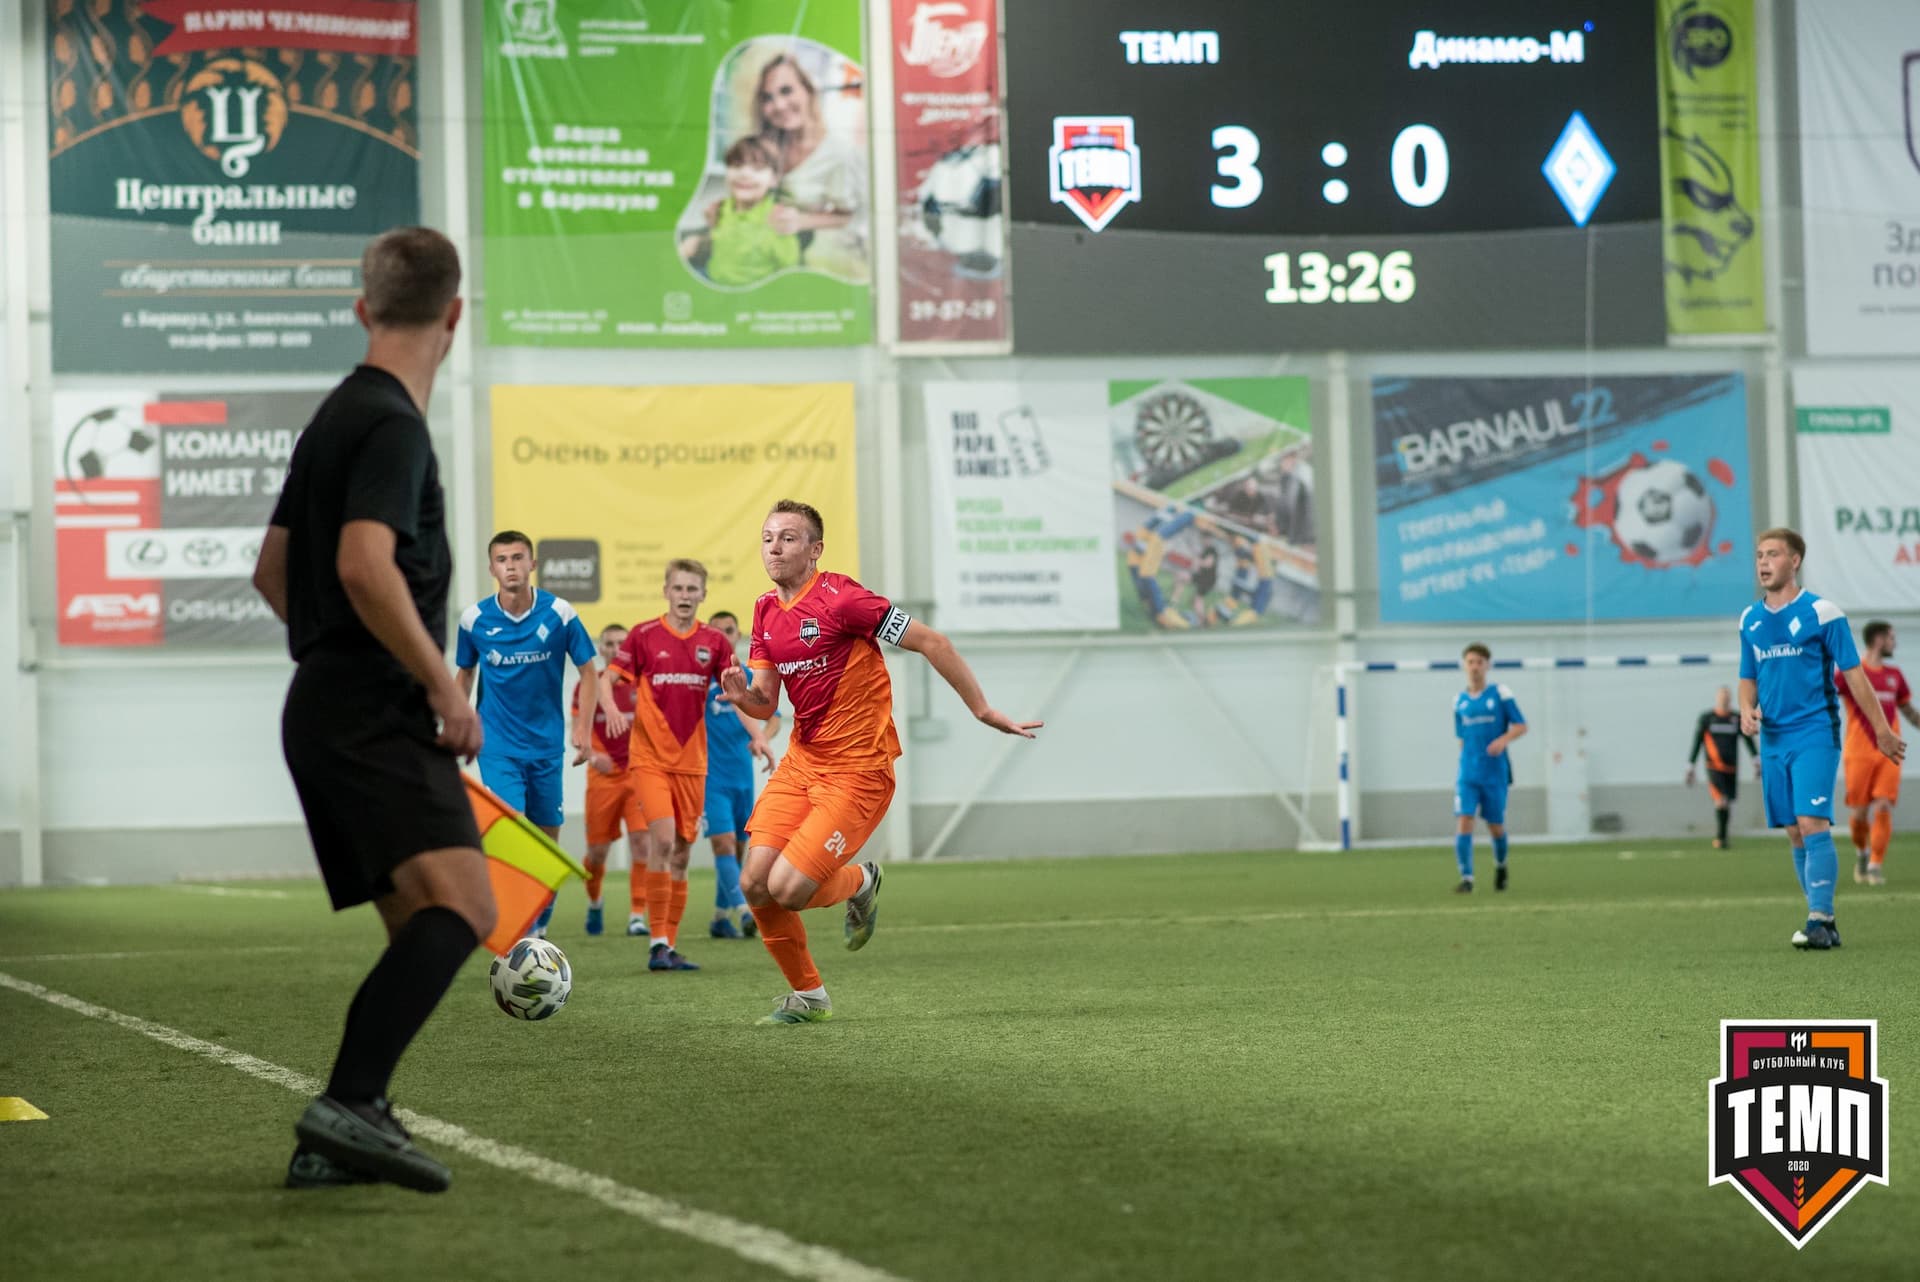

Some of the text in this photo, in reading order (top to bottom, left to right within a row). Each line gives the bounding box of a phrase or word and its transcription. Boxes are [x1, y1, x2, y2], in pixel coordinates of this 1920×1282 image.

[1119, 31, 1219, 64] ТЕМП
[1408, 30, 1584, 68] Динамо-М
[1211, 125, 1264, 207] 3
[1390, 124, 1450, 207] 0
[115, 178, 357, 216] Центральные
[192, 212, 281, 245] бани
[120, 264, 291, 293] общественные
[1264, 252, 1415, 304] 13:26
[512, 436, 837, 470] Очень хорошие окна
[166, 468, 256, 497] ИМЕЕТ
[824, 830, 846, 859] 24
